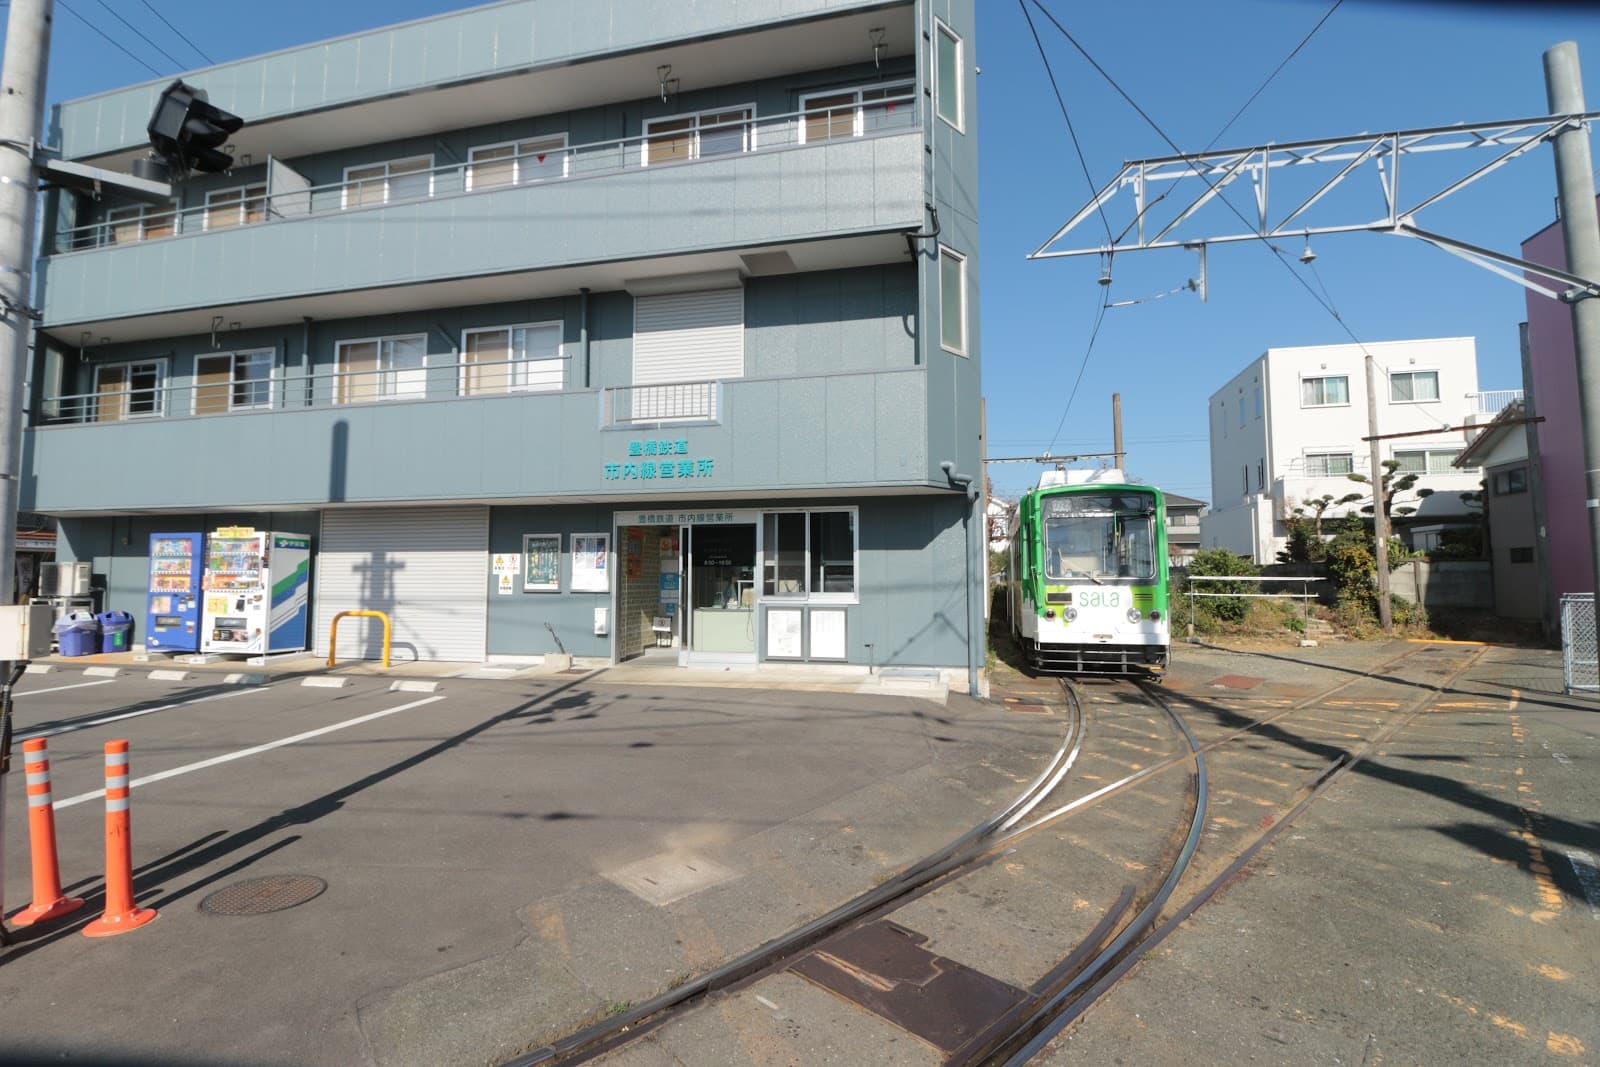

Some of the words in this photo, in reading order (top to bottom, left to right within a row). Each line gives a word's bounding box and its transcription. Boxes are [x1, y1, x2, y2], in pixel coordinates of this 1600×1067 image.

[629, 440, 688, 456] 豊橋鉄道
[604, 458, 714, 480] 市内線営業所
[678, 511, 733, 523] 市内線営業所
[1079, 592, 1120, 608] sala
